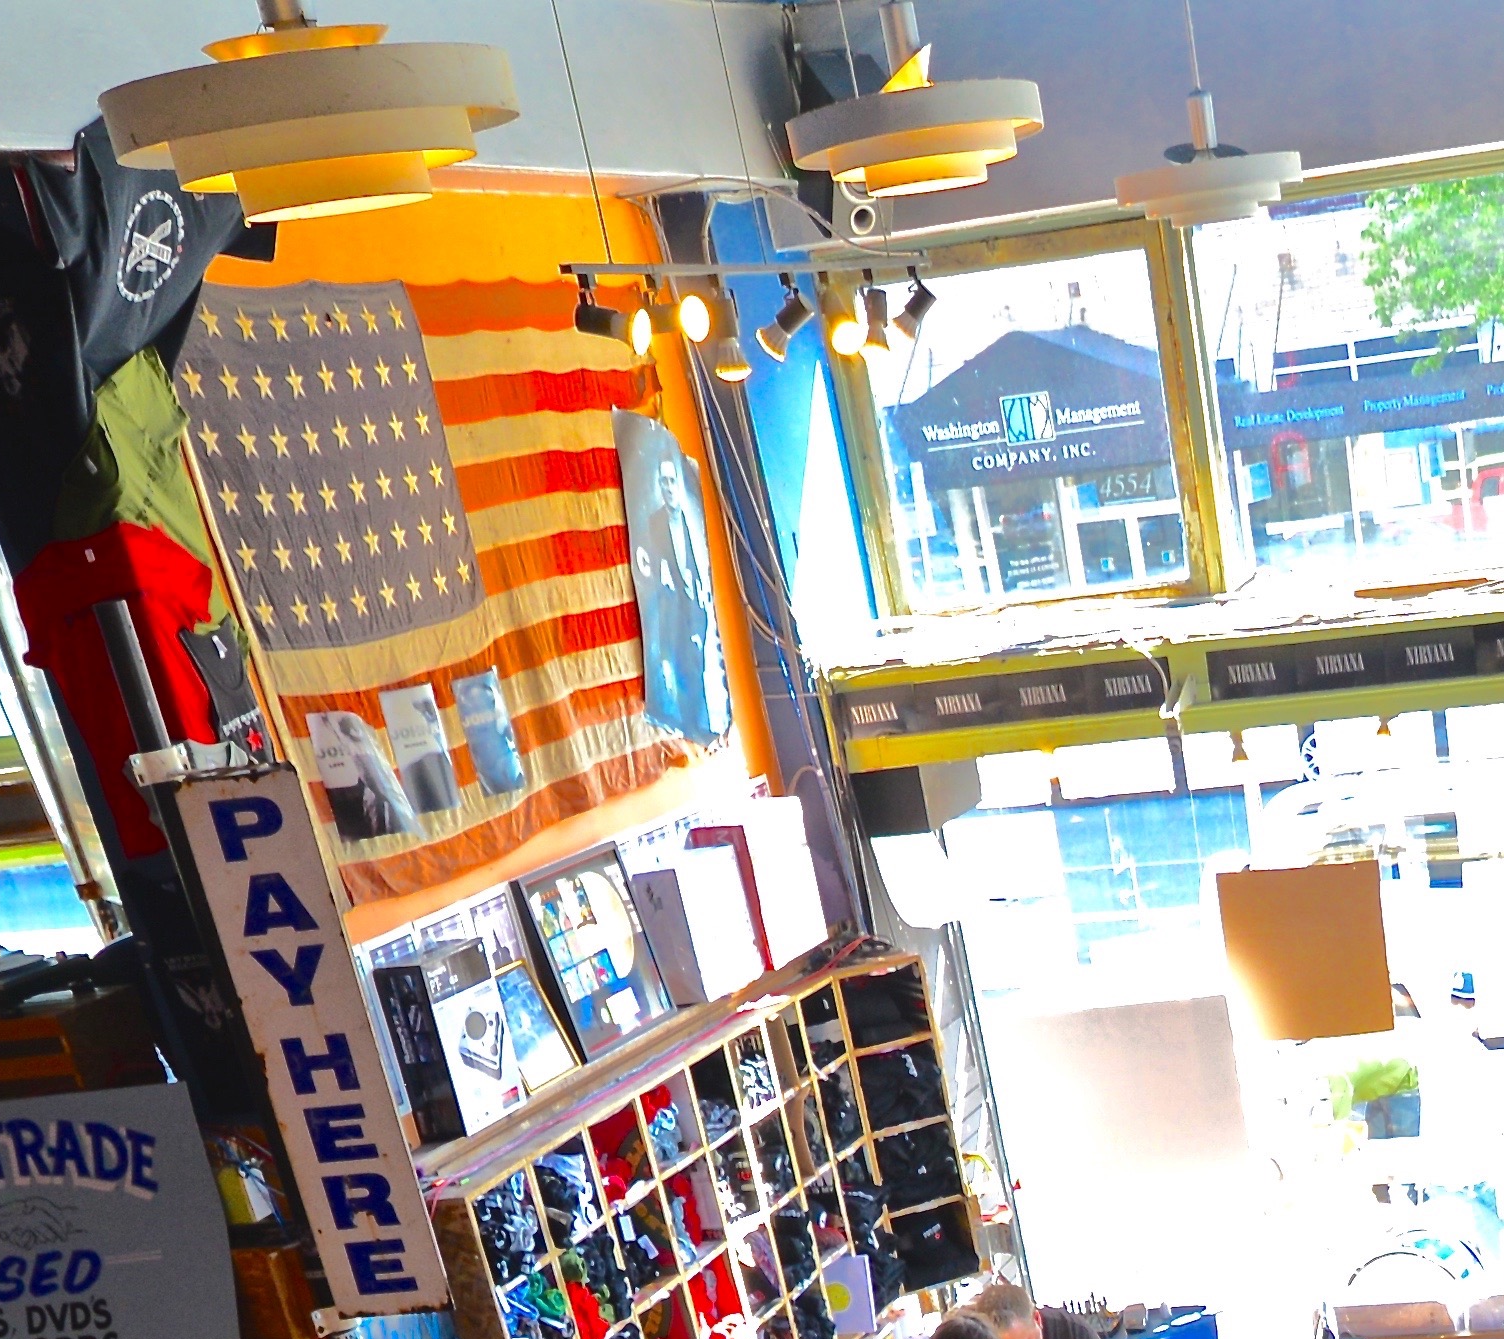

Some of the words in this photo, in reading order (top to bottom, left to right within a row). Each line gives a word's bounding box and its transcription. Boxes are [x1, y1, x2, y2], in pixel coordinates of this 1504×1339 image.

[922, 415, 1000, 444] Washington
[1056, 398, 1141, 425] Management
[971, 444, 1057, 472] COMPANY,
[1062, 442, 1096, 460] INC.
[1098, 471, 1156, 498] 4554
[1315, 651, 1365, 677] NIRVANA
[1405, 642, 1455, 667] NIRVANA
[1103, 673, 1152, 699] NIRVANA
[1227, 660, 1277, 686] NIRVANA
[935, 691, 984, 717] NIRVANA
[1018, 682, 1067, 708] NIRVANA
[851, 700, 898, 725] NIRVANA
[208, 796, 326, 1007] PAY
[281, 1036, 420, 1297] HERE
[25, 1294, 113, 1337] DVD'S
